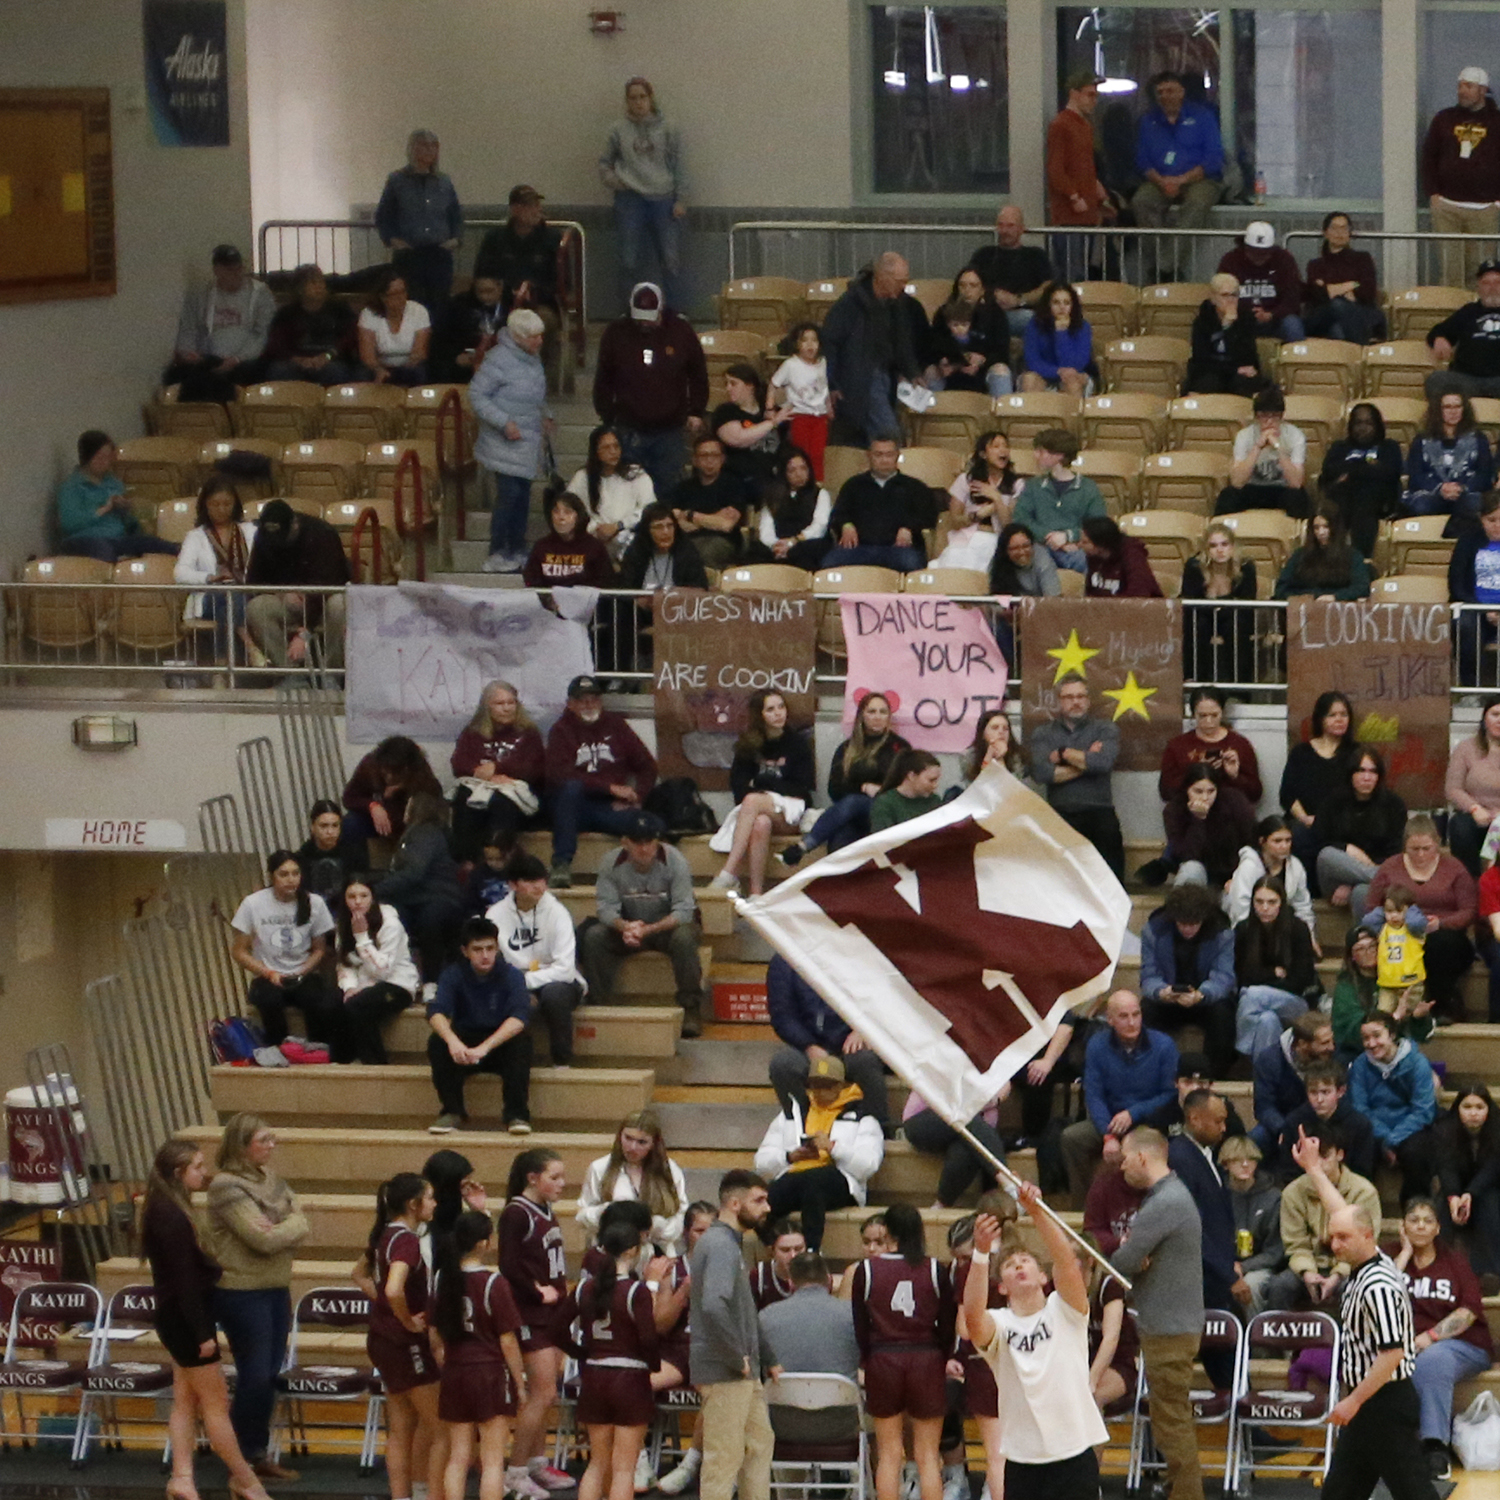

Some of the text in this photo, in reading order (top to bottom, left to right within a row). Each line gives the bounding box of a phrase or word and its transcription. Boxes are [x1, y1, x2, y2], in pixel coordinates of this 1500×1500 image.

[164, 33, 219, 84] Alaska
[661, 592, 806, 624] GUESS WHAT
[855, 600, 955, 637] DANCE
[1302, 602, 1450, 649] LOOKING
[911, 642, 995, 677] YOUR
[657, 662, 708, 691] ARE
[913, 694, 999, 729] OUT
[83, 821, 147, 846] HOME
[803, 815, 1112, 1074] K
[1386, 945, 1403, 962] 23
[30, 1293, 86, 1309] KAYHI
[311, 1298, 370, 1315] KAYHI
[891, 1280, 916, 1318] 4
[1262, 1320, 1323, 1338] KAYHI
[87, 1377, 135, 1390] KINGS
[288, 1378, 339, 1393] KINGS
[668, 1390, 702, 1404] KIN
[1250, 1404, 1303, 1420] KINGS
